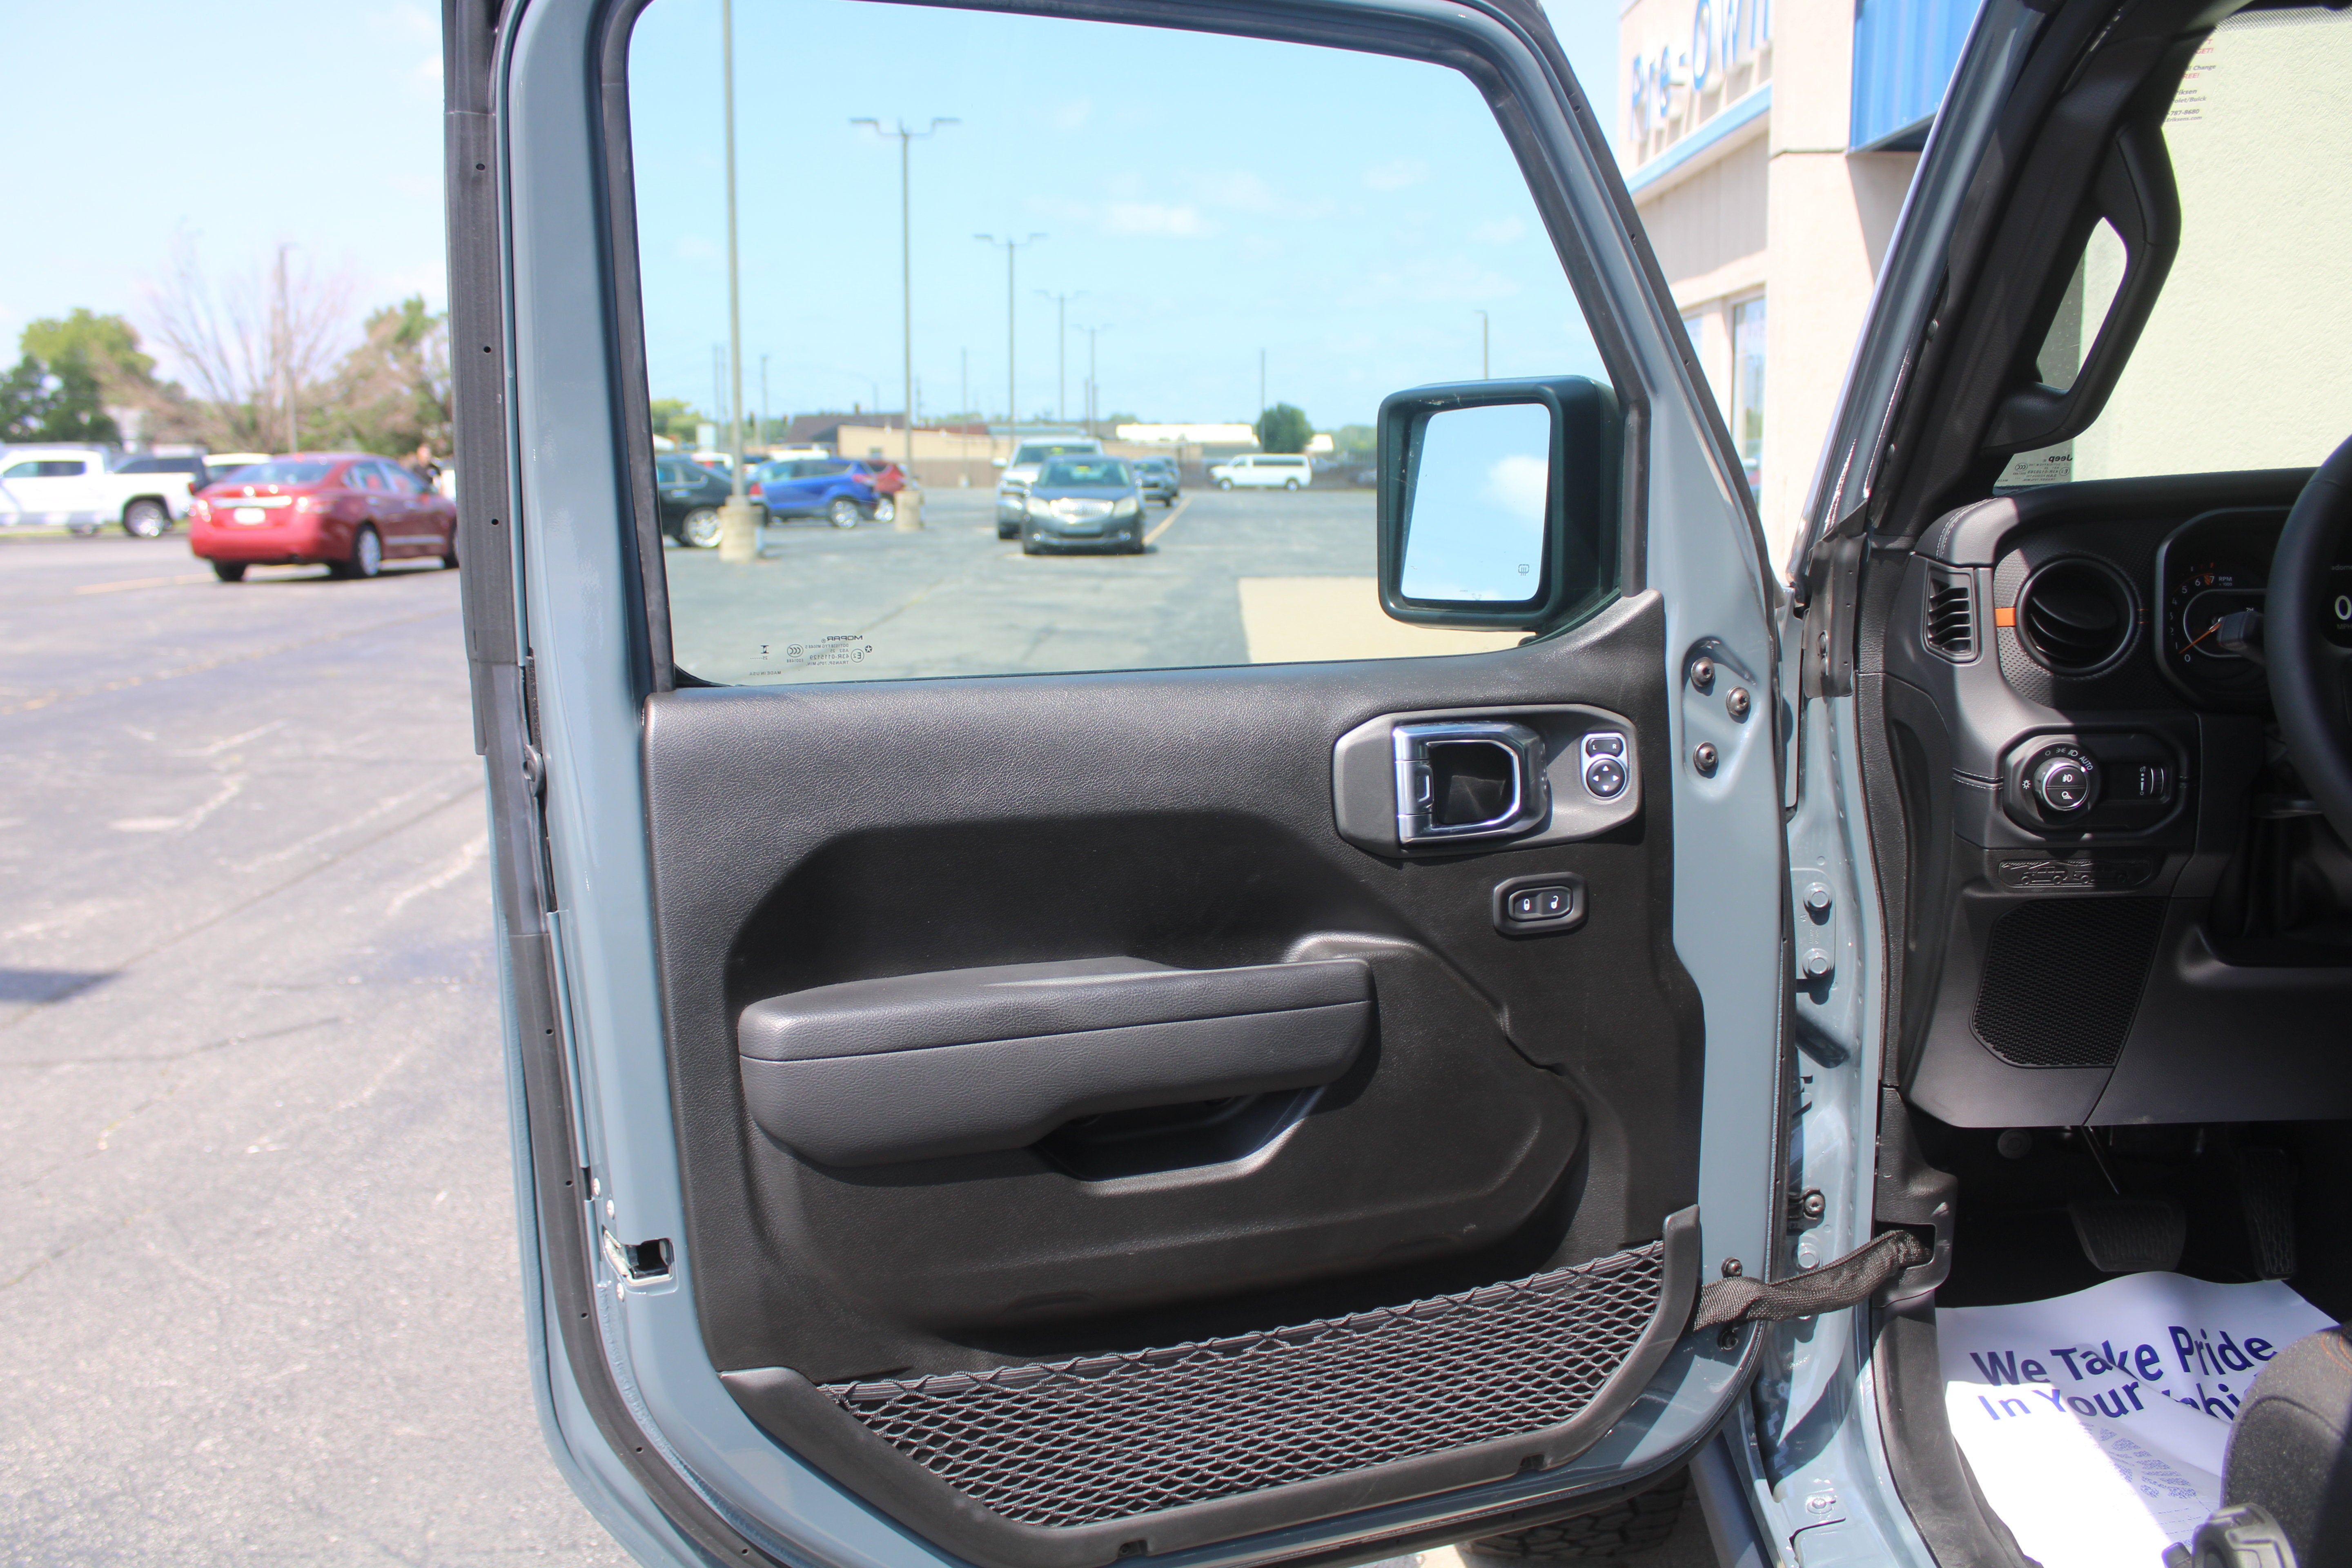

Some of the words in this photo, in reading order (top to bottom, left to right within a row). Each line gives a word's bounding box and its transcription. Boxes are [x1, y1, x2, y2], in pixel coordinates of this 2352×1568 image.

[2334, 595, 2352, 620] 0
[2079, 756, 2093, 770] AUTO
[1969, 1350, 2051, 1386] We
[2049, 1340, 2163, 1381] Take
[2168, 1326, 2278, 1375] Pride
[1978, 1395, 2031, 1420] In
[2031, 1382, 2144, 1418] Your
